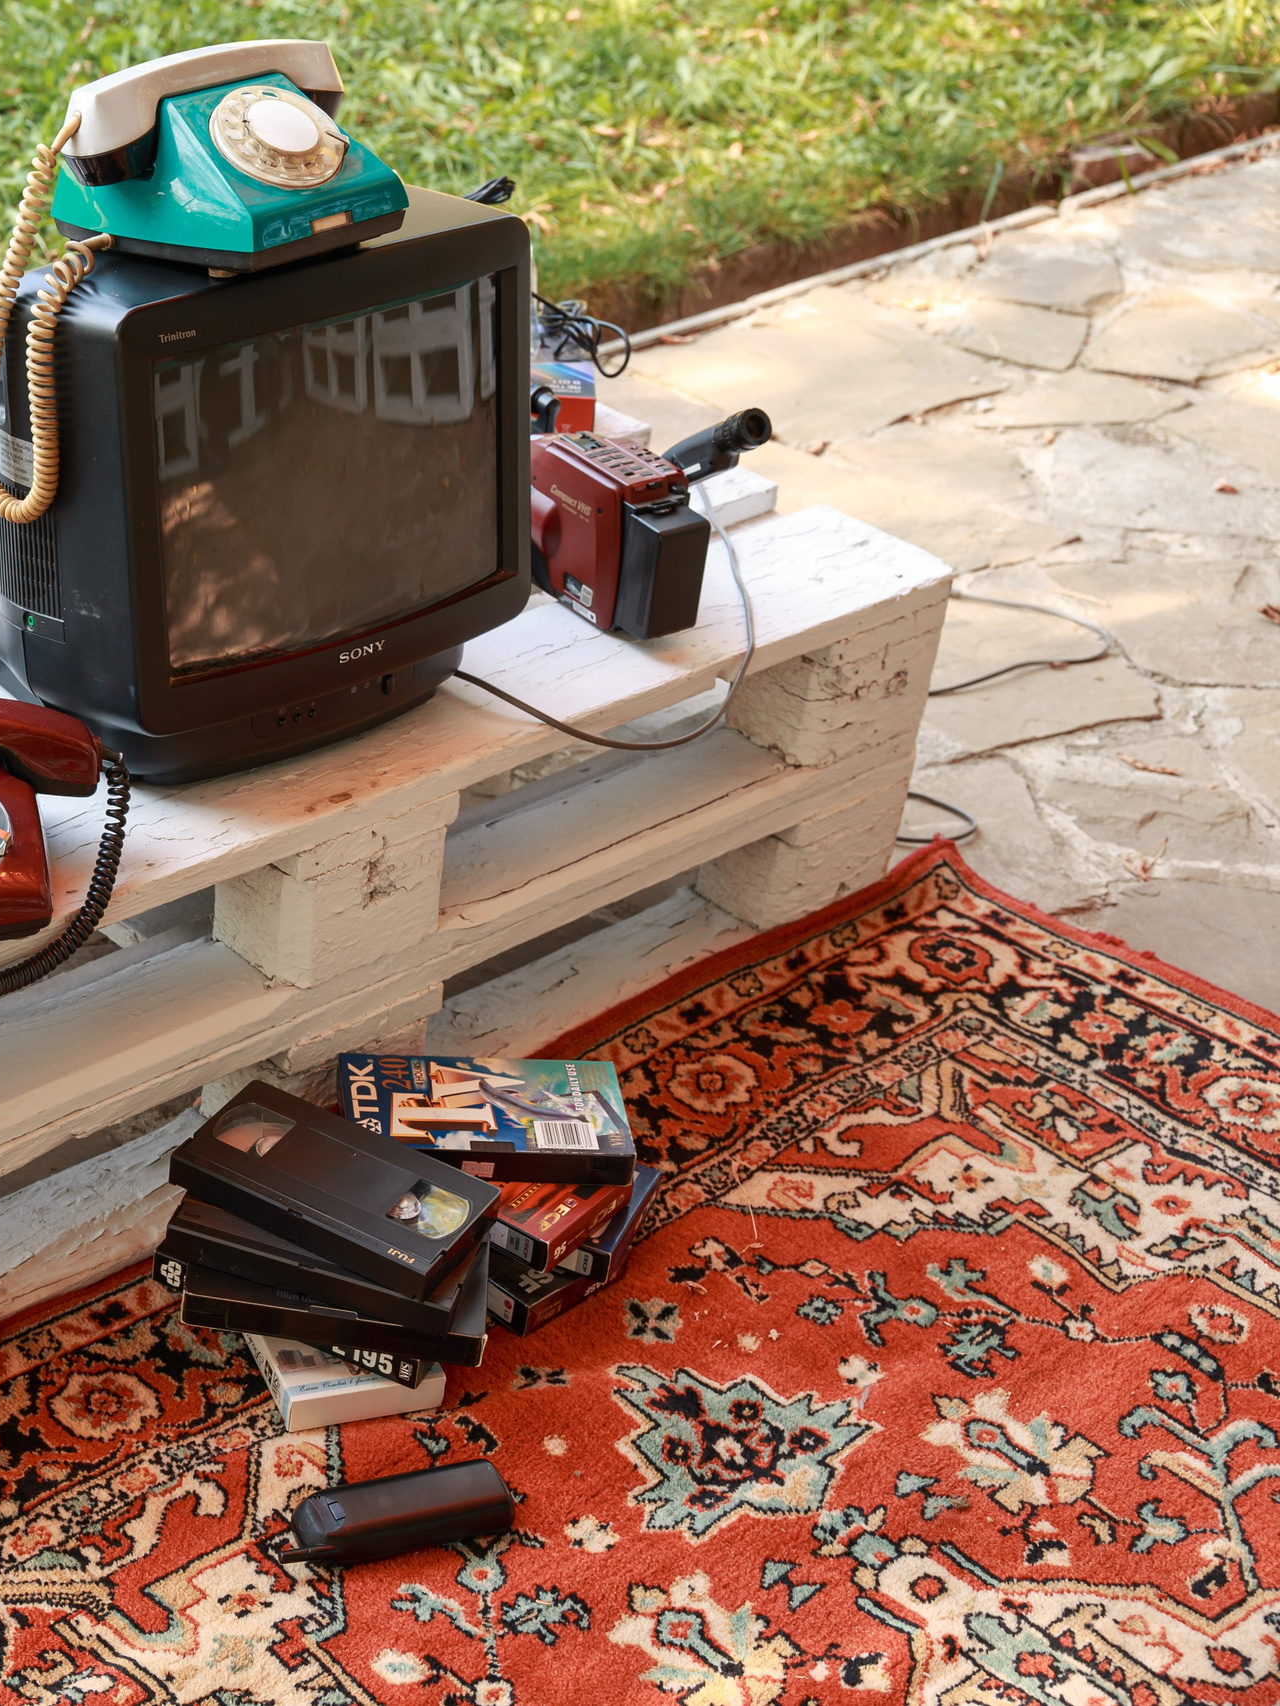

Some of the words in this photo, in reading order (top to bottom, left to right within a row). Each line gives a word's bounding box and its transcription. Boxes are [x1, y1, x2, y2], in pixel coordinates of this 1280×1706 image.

[158, 328, 197, 344] Trinitron
[550, 484, 577, 508] Compact
[576, 500, 593, 516] VHS
[338, 639, 387, 665] SONY
[378, 1058, 412, 1091] 240
[412, 1061, 424, 1083] HOURS
[564, 1063, 578, 1077] USE
[347, 1063, 379, 1118] TDK
[568, 1077, 581, 1097] DAILY
[390, 1061, 526, 1144] TV
[574, 1096, 585, 1111] FOR
[538, 1203, 571, 1232] ECP
[387, 1248, 416, 1265] FUJI
[553, 1241, 567, 1260] SG
[518, 1269, 560, 1294] SF
[584, 1281, 603, 1297] ASF
[275, 1289, 300, 1301] HIGH
[503, 1310, 510, 1320] LG
[400, 1361, 413, 1381] VHS
